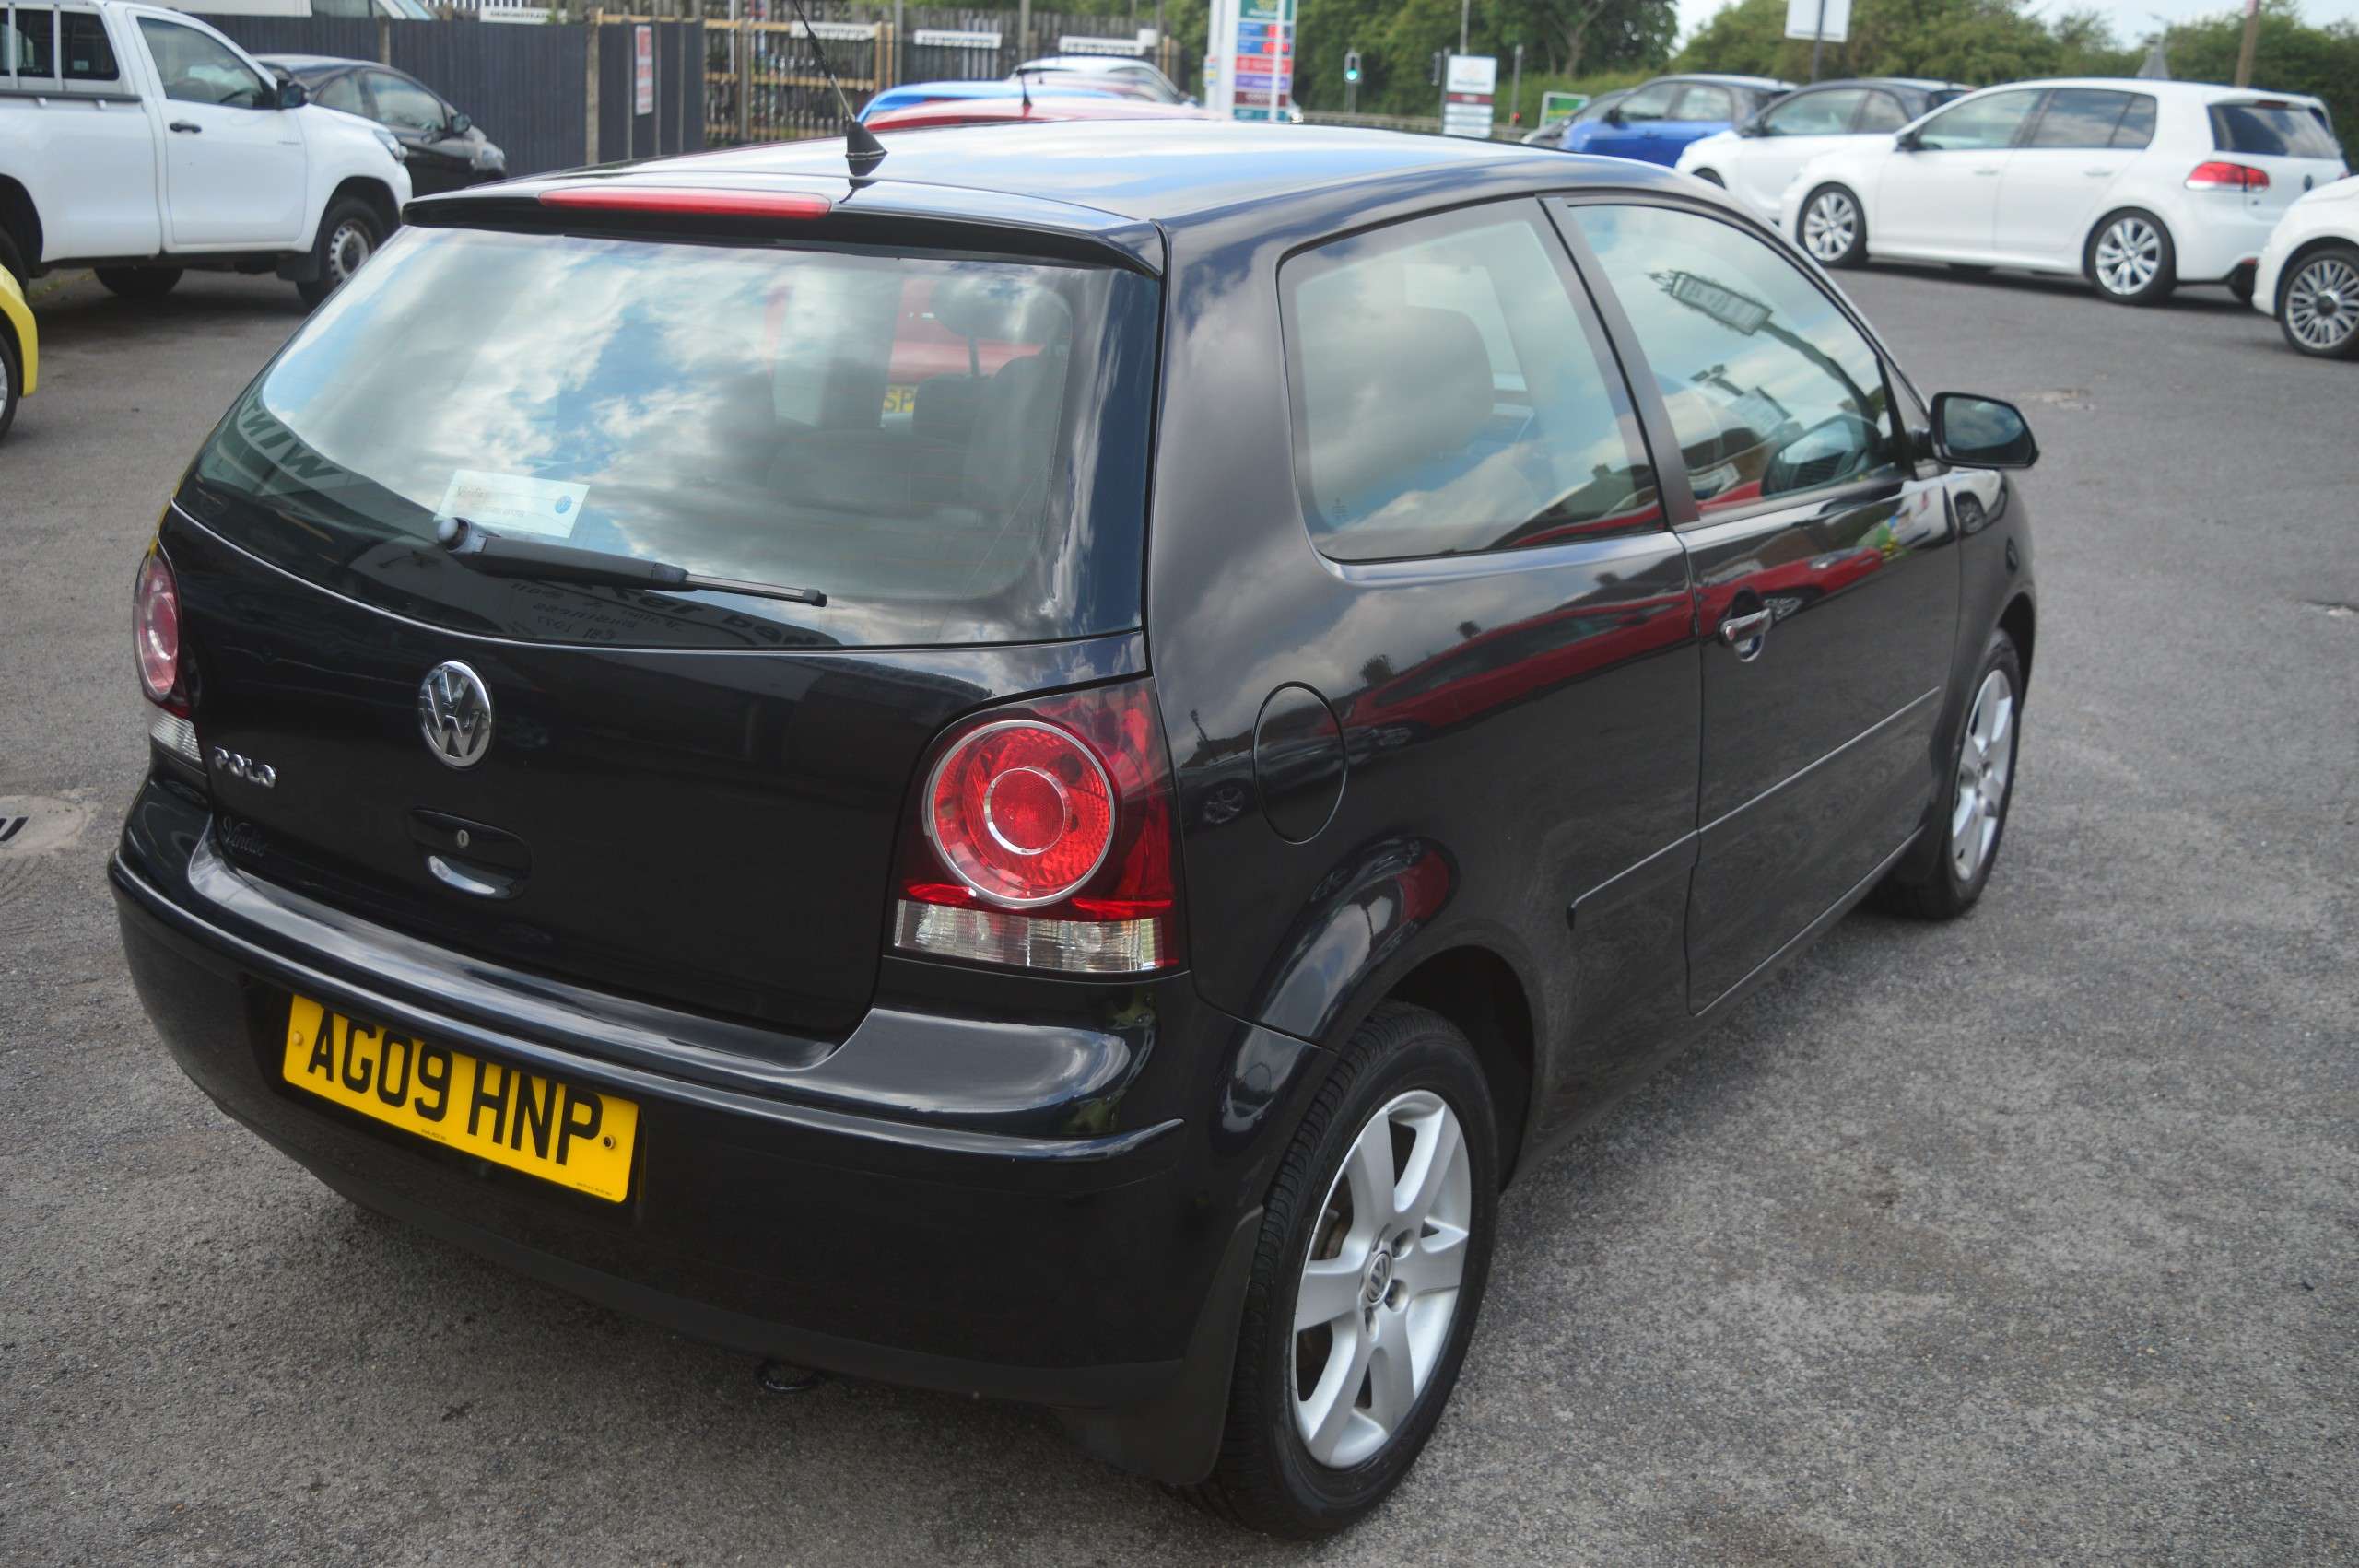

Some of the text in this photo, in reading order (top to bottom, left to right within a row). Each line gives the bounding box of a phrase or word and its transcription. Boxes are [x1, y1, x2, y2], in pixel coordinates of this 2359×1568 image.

[214, 746, 277, 789] POLO
[307, 1011, 604, 1166] AG09 HNP
